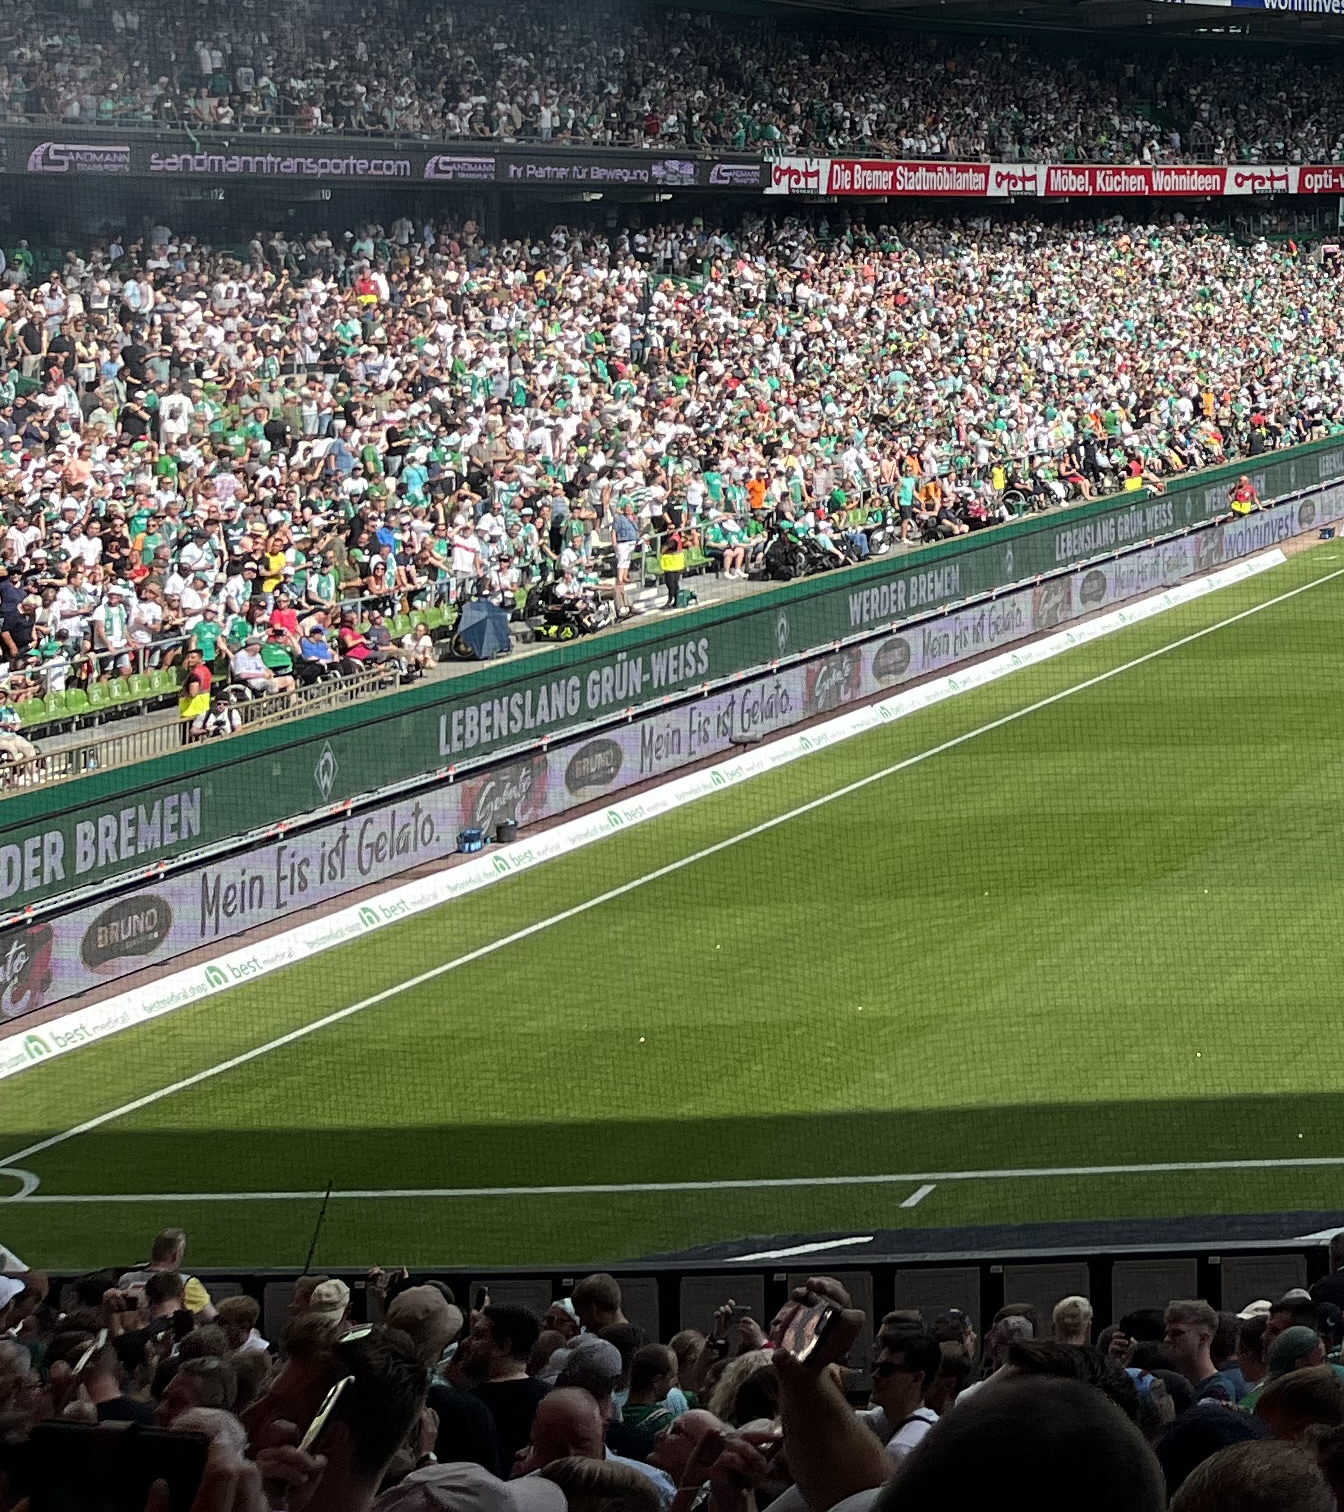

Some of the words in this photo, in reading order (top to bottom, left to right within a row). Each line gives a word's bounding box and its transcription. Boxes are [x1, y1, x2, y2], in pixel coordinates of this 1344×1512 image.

[150, 151, 411, 179] sandmanntransporte.com
[509, 164, 523, 178] Ihr
[526, 164, 570, 179] Partner
[573, 165, 589, 180] für
[591, 166, 649, 183] Bewegung
[832, 164, 851, 188] Die
[854, 165, 893, 189] Bremer
[896, 165, 985, 192] Stadtmöbilanten
[1051, 168, 1093, 194] Möbel,
[1097, 169, 1149, 194] Küchen,
[1152, 170, 1220, 191] Wohnideen
[1056, 514, 1115, 561] LEBENSLANG
[1117, 500, 1173, 542] GRÜN-WEISS
[1224, 510, 1295, 560] wohninvest
[850, 576, 907, 626] WERDER
[909, 564, 960, 607] BREMEN
[922, 625, 950, 669] Mein
[953, 614, 969, 657] Eis
[971, 609, 986, 646] ist
[440, 675, 581, 756] LEBENSLANG
[587, 638, 709, 709] GRÜN-WEISS
[640, 720, 681, 775] Mein
[689, 703, 709, 757] Eis
[716, 692, 735, 744] ist
[741, 677, 793, 733] Gelato.
[75, 787, 201, 875] BREMEN
[200, 870, 264, 938] Mein
[276, 844, 310, 910] Eis
[320, 826, 349, 885] ist
[358, 801, 440, 876] Gelato.
[511, 847, 538, 867] best
[96, 906, 158, 950] BRUNO
[379, 897, 411, 919] best
[228, 955, 262, 980] best
[52, 1023, 93, 1049] best
